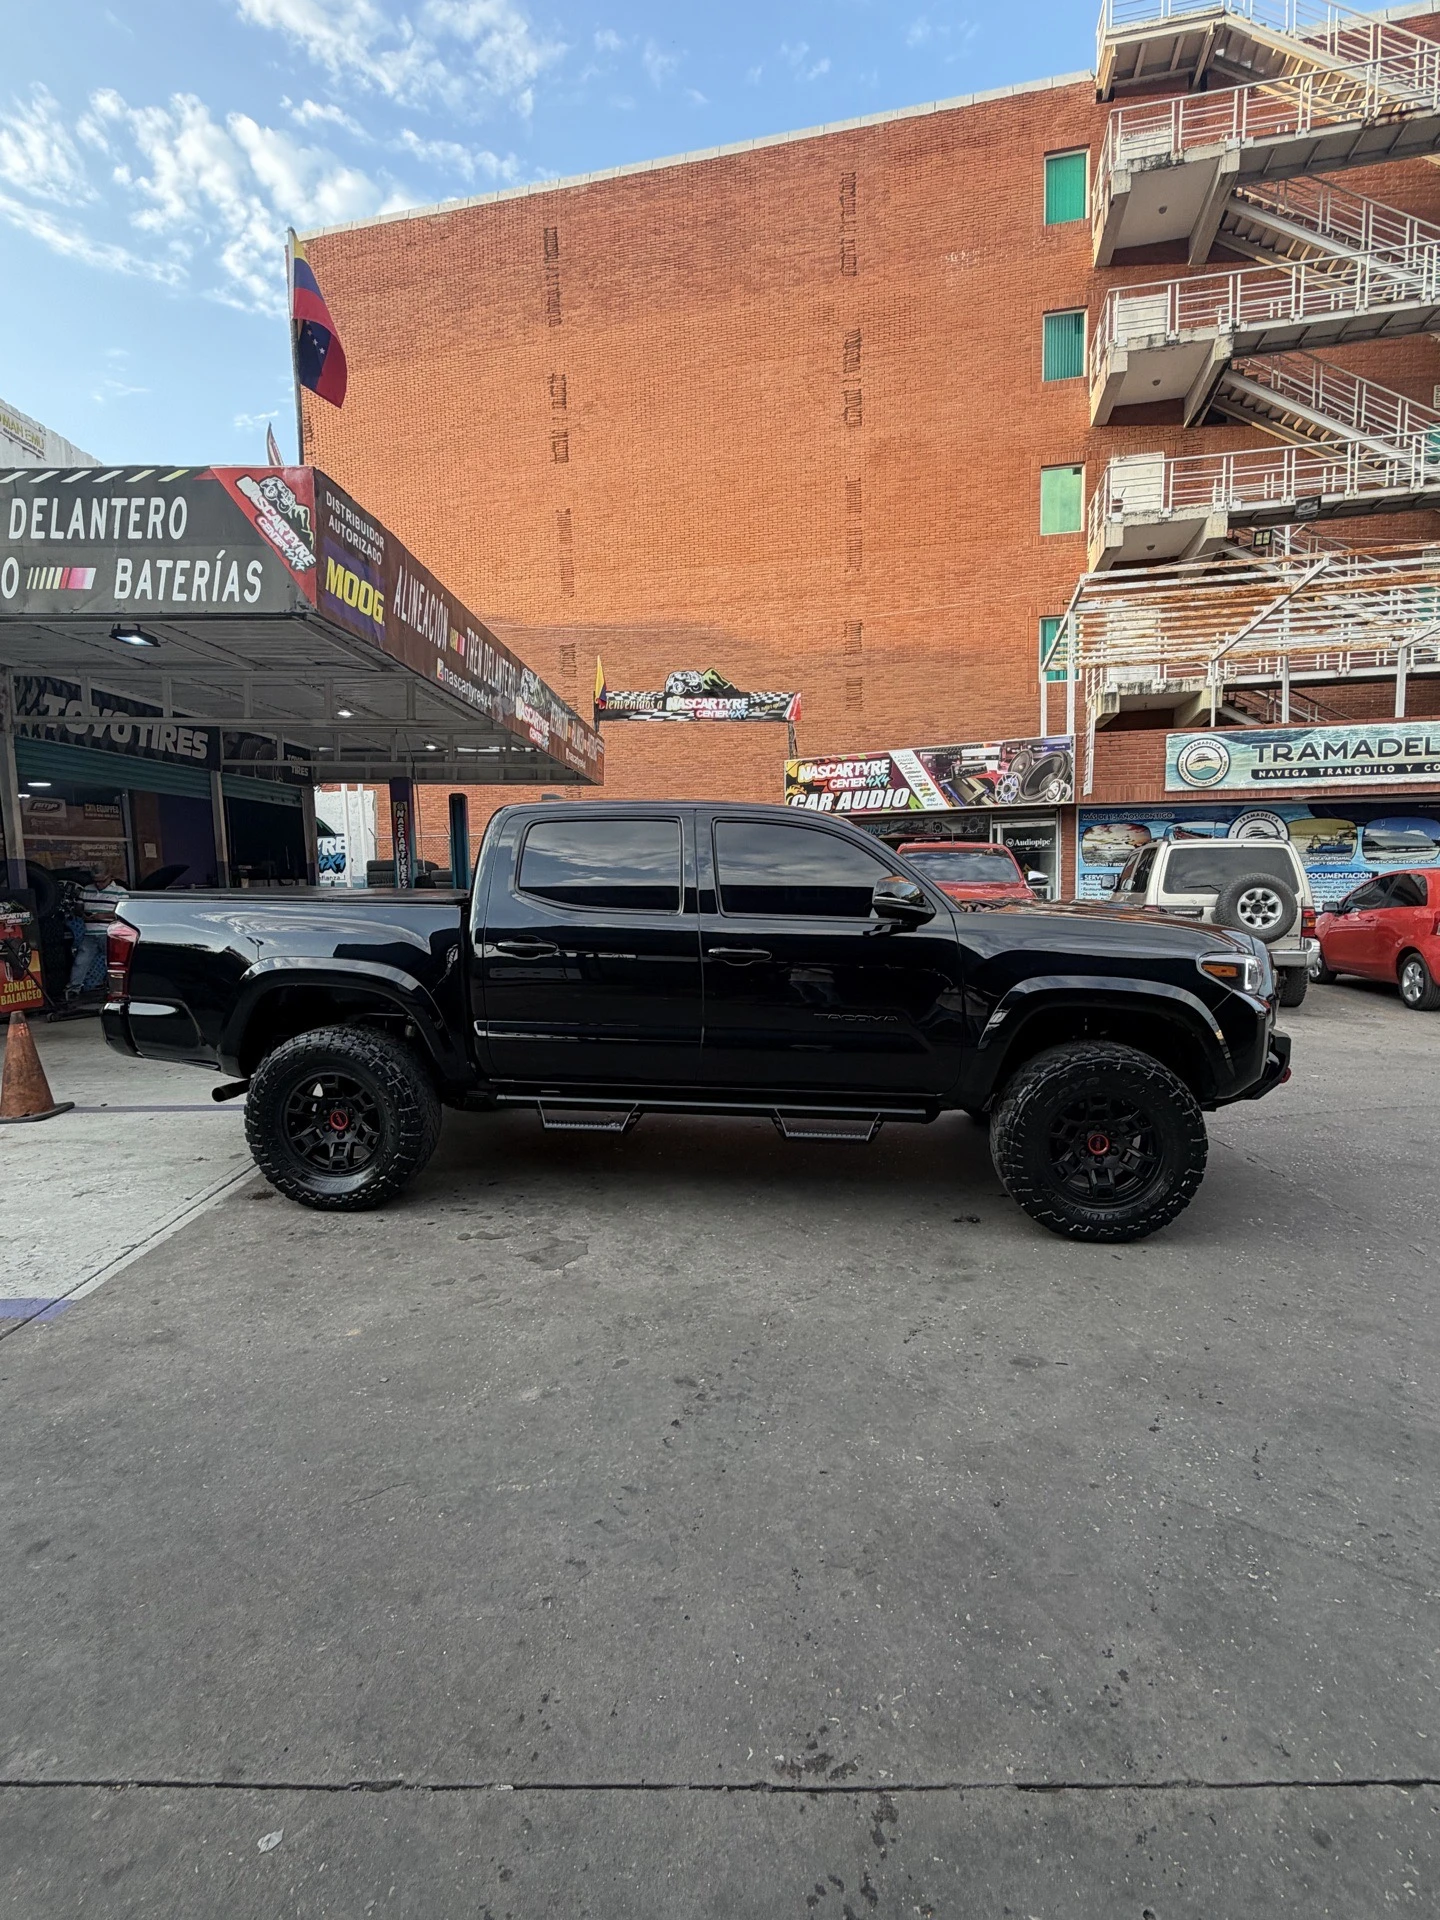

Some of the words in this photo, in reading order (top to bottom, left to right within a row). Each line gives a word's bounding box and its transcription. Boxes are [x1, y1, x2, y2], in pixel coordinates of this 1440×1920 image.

[8, 496, 188, 540] DELANTERO
[326, 491, 385, 551] DISTRIBUIDOR
[328, 515, 382, 565] AUTORIZADO
[114, 549, 263, 603] BATERÍAS
[325, 556, 385, 625] MOOG
[393, 565, 449, 652] ALINEACIÓN
[465, 627, 484, 679] TREN
[600, 697, 654, 710] ienvenidos
[665, 695, 749, 711] NASCARTYRE
[43, 693, 132, 743] TOYO
[695, 710, 729, 718] CENTER
[134, 721, 209, 760] TIRES
[1187, 741, 1221, 751] TRAMADELCA
[1251, 737, 1440, 763] TRAMADEL
[798, 758, 891, 783] NASCARTYRE
[1258, 769, 1309, 778] NAVEGA
[1318, 765, 1396, 776] TRANQUILO
[1405, 764, 1414, 772] Y
[829, 777, 867, 789] CENTER
[866, 773, 890, 788] 4X4
[790, 792, 835, 811] CAR
[836, 787, 911, 811] AUDIO
[1118, 811, 1140, 820] AÑOS
[1238, 812, 1279, 824] TRAMADELCA
[1014, 837, 1051, 847] Audiopipe
[1306, 871, 1373, 879] DOCUMENTACIÓN
[3, 981, 26, 993] ZONA
[0, 989, 42, 1006] BALANCEO
